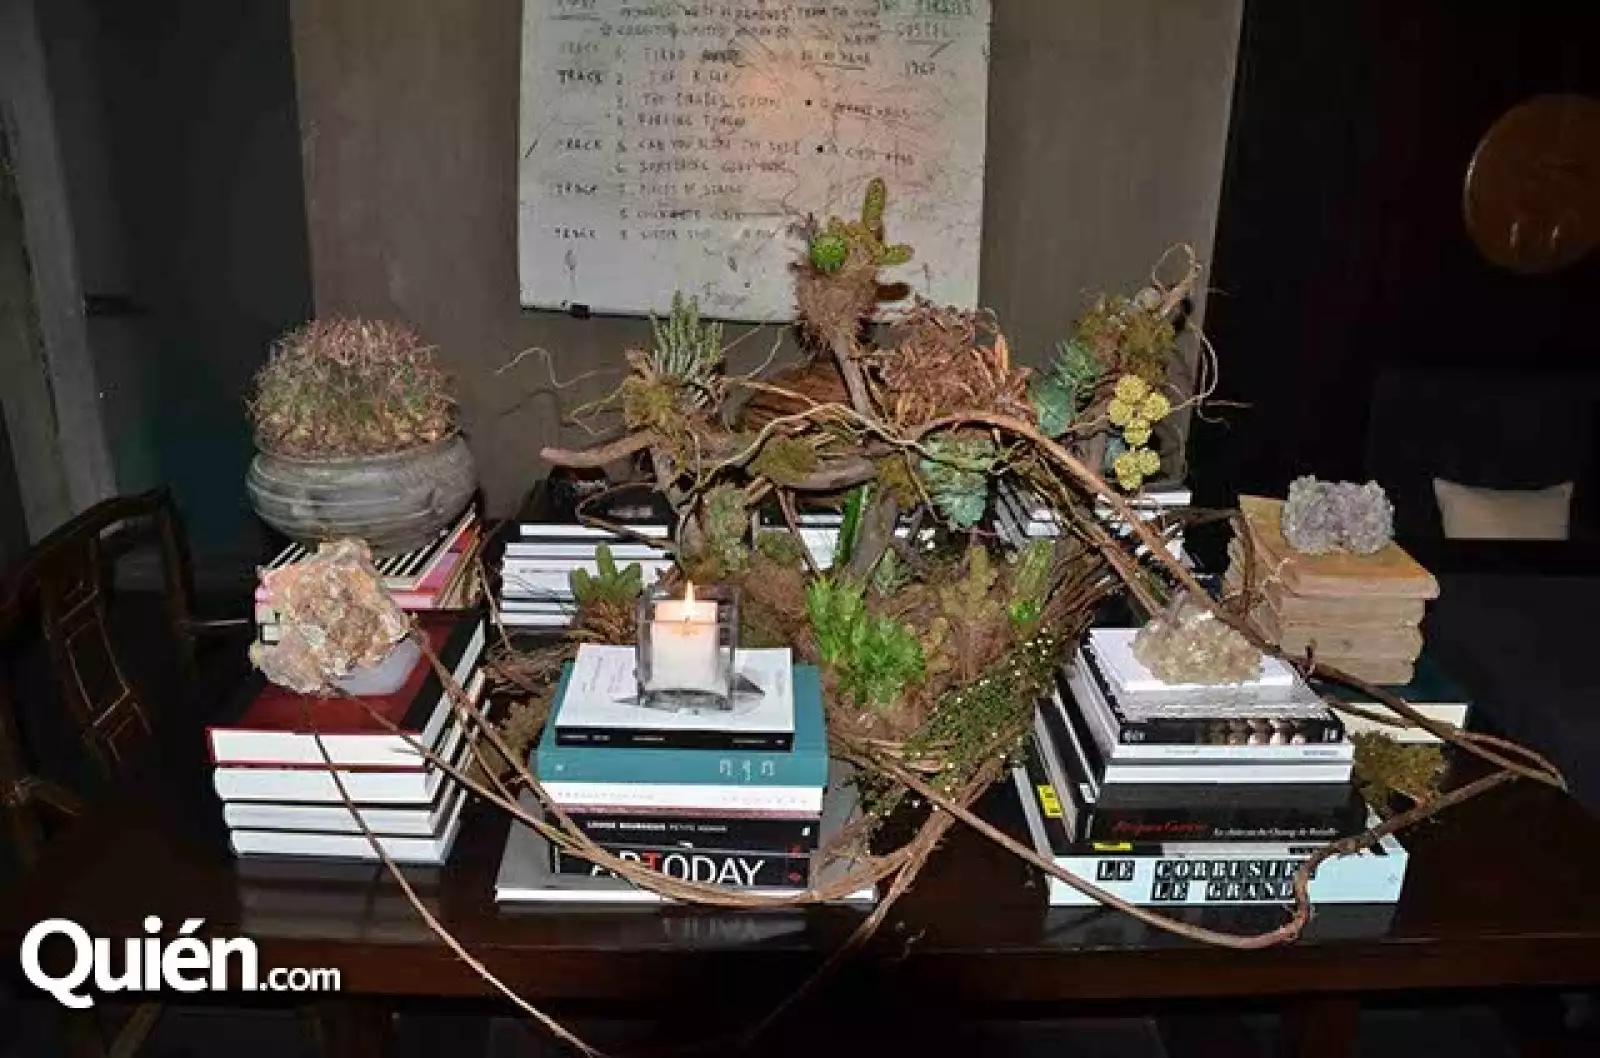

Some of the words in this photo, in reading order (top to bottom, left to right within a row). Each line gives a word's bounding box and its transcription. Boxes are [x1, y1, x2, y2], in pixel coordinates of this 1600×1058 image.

[1097, 860, 1134, 880] LE
[1154, 860, 1315, 881] CORBUSIE
[1152, 882, 1188, 900] LE
